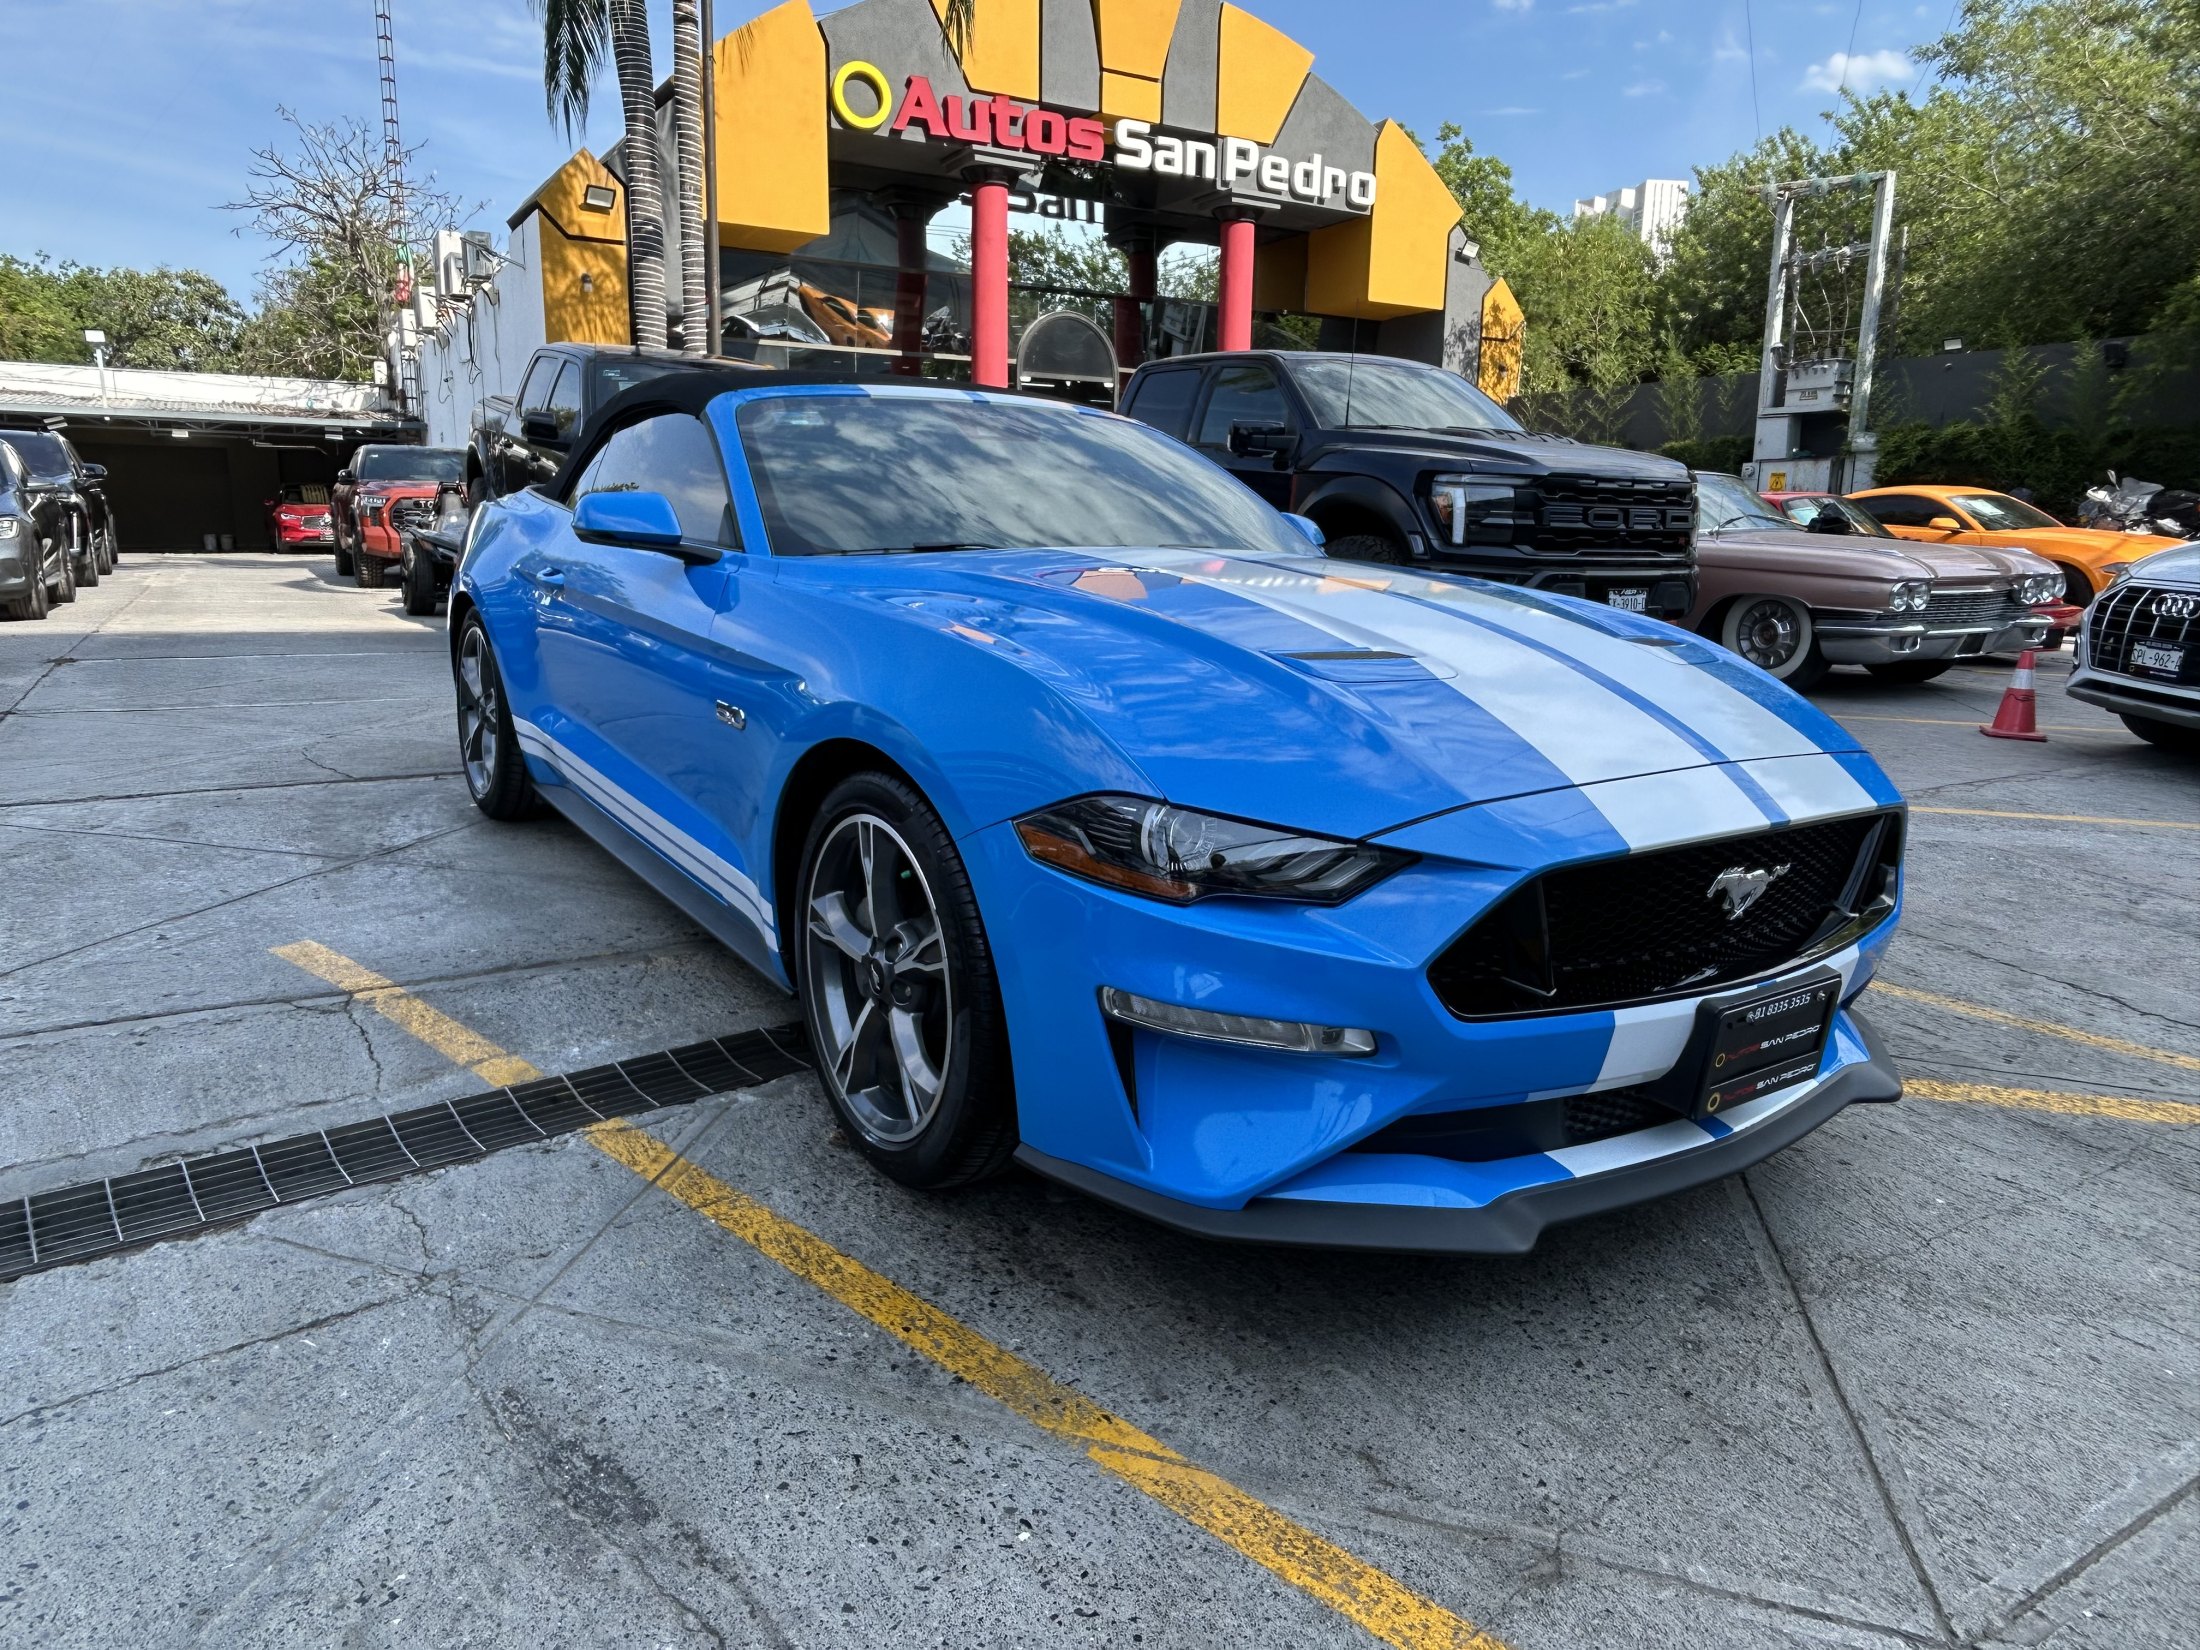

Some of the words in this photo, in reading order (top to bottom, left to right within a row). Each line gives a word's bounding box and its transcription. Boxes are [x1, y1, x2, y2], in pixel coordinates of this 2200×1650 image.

[893, 75, 1105, 162] Autos
[1113, 118, 1216, 180] San
[1223, 136, 1377, 208] Pedro
[1543, 506, 1693, 529] FORD
